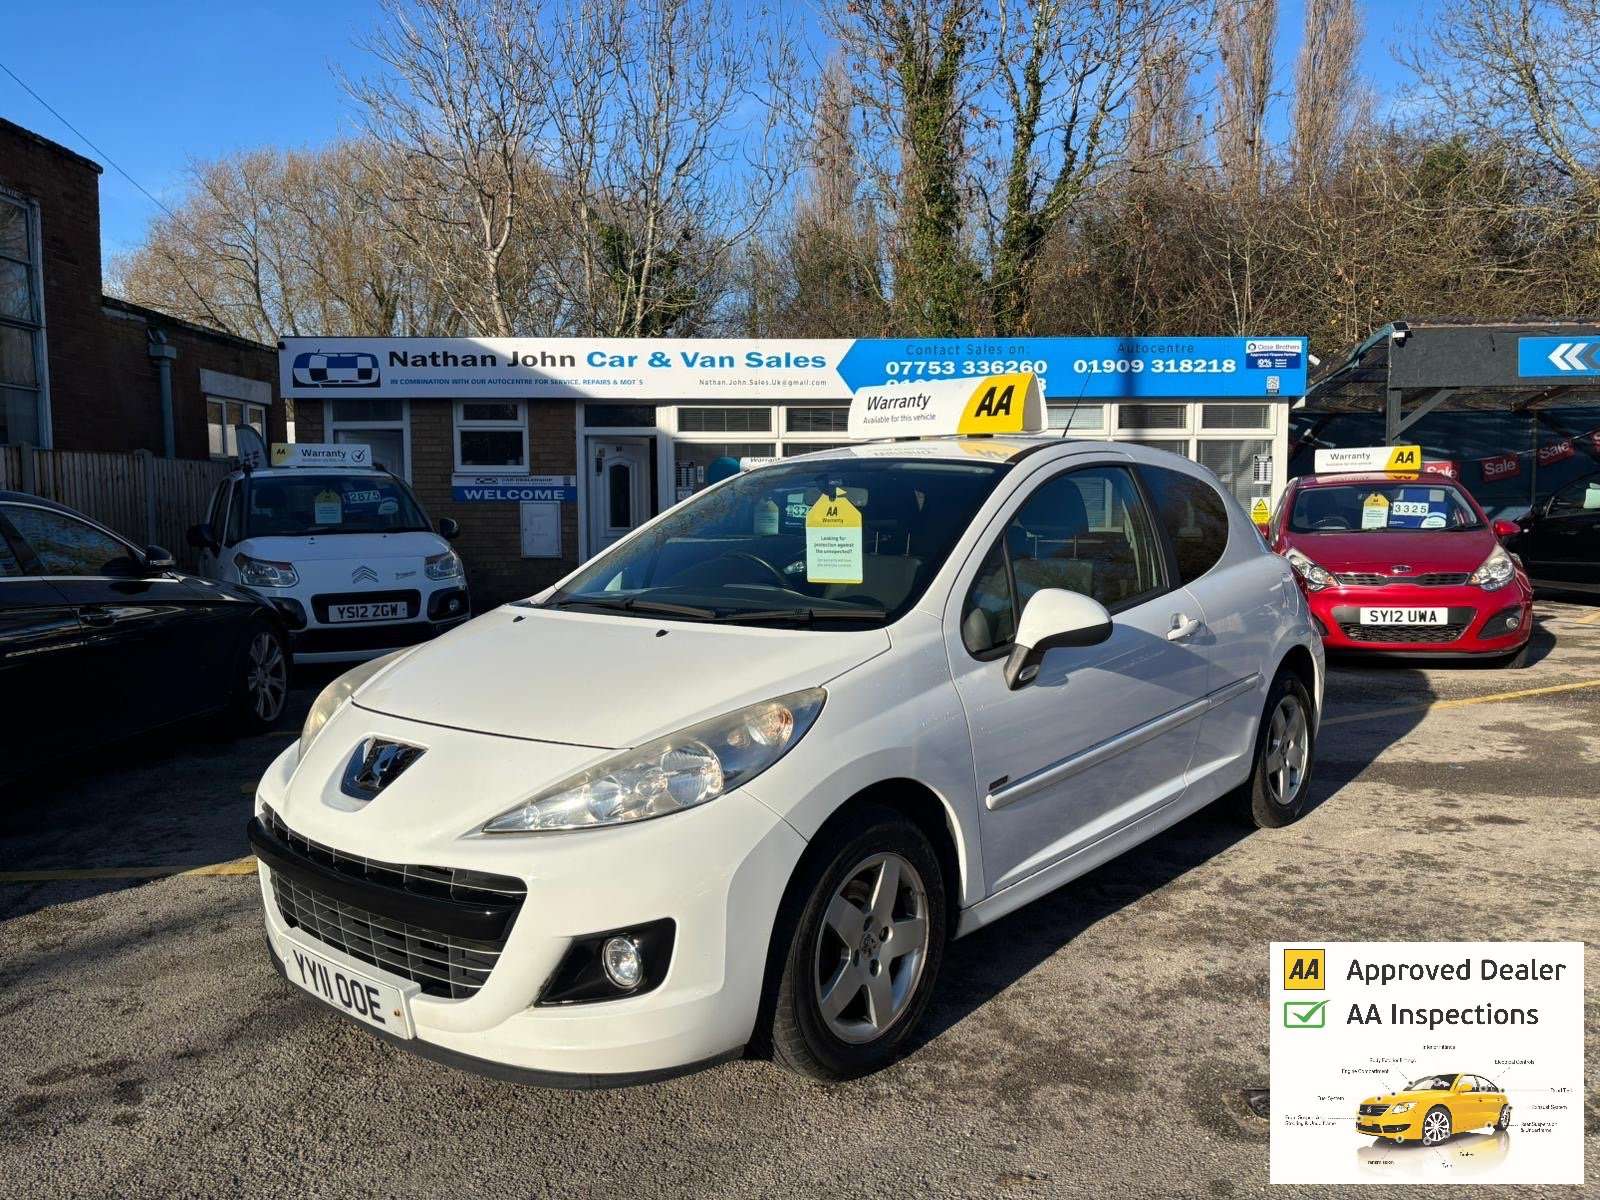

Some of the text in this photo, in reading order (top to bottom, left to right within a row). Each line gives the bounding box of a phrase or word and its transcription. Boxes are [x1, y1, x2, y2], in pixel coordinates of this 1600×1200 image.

[905, 344, 1031, 355] Contact Sales on:
[1116, 342, 1195, 353] Autocentre
[388, 351, 827, 368] Nathan John Car & Van Sales
[1073, 359, 1237, 373] 01909 318218
[885, 360, 1048, 375] 07753 336260
[699, 378, 828, 386] Nathan.John.Sales.Uk@gmail.com
[868, 392, 931, 411] Warranty
[974, 384, 1016, 417] AA
[863, 415, 890, 424] Available
[900, 414, 912, 422] this
[912, 413, 937, 421] vehicle
[276, 448, 346, 459] AA Warranty
[1538, 439, 1570, 460] Sale
[1330, 451, 1414, 464] Warranty AA
[1484, 459, 1516, 476] Sale
[464, 489, 565, 500] WELCOME
[826, 506, 838, 517] AA
[1395, 504, 1427, 514] 3325
[337, 603, 398, 620] YS12 ZGW
[1370, 610, 1437, 623] SY12 UWA
[292, 949, 335, 1000] YY11
